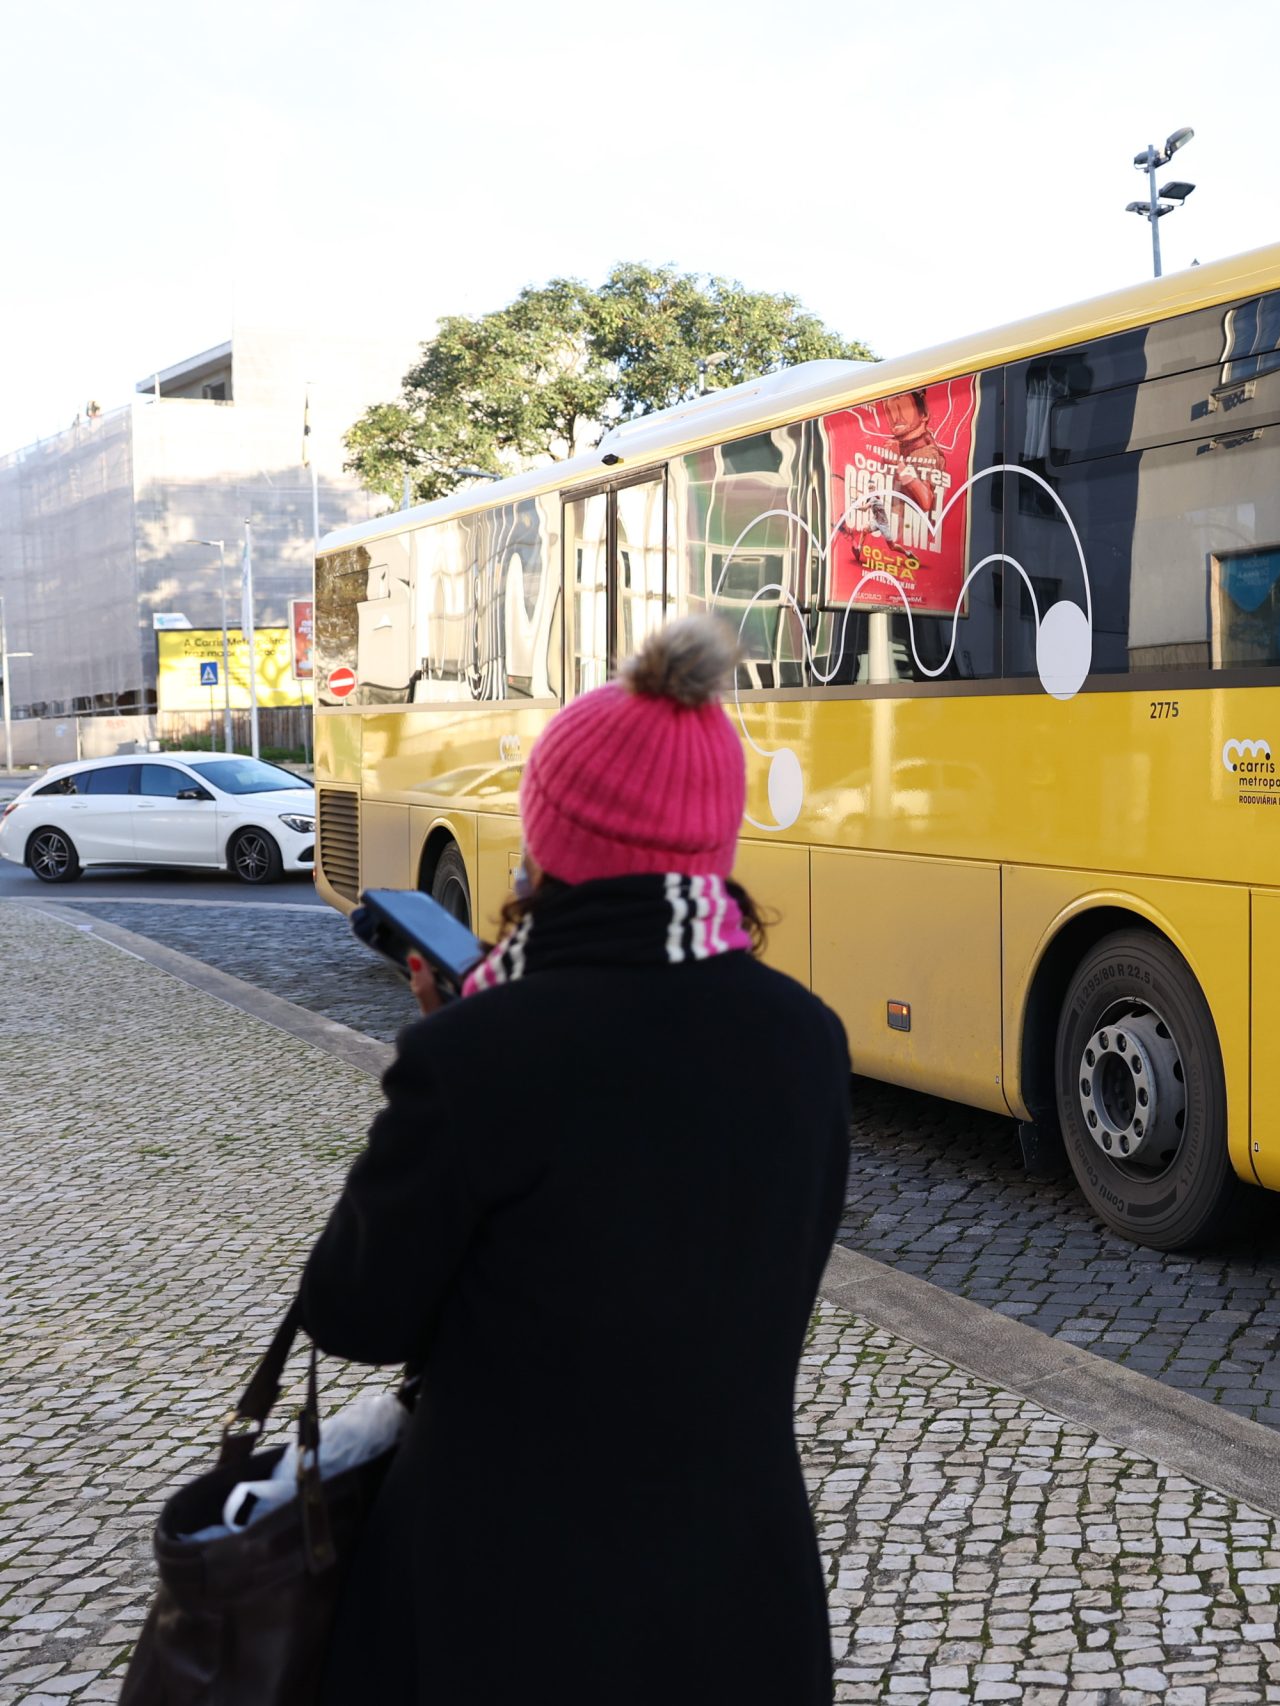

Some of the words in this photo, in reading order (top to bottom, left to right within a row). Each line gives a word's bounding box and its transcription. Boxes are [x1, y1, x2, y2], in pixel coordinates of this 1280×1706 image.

[1150, 701, 1179, 719] 2775
[1239, 760, 1276, 774] carris
[1239, 794, 1277, 806] RODOVIÁRIA
[1127, 963, 1151, 985] 22.5
